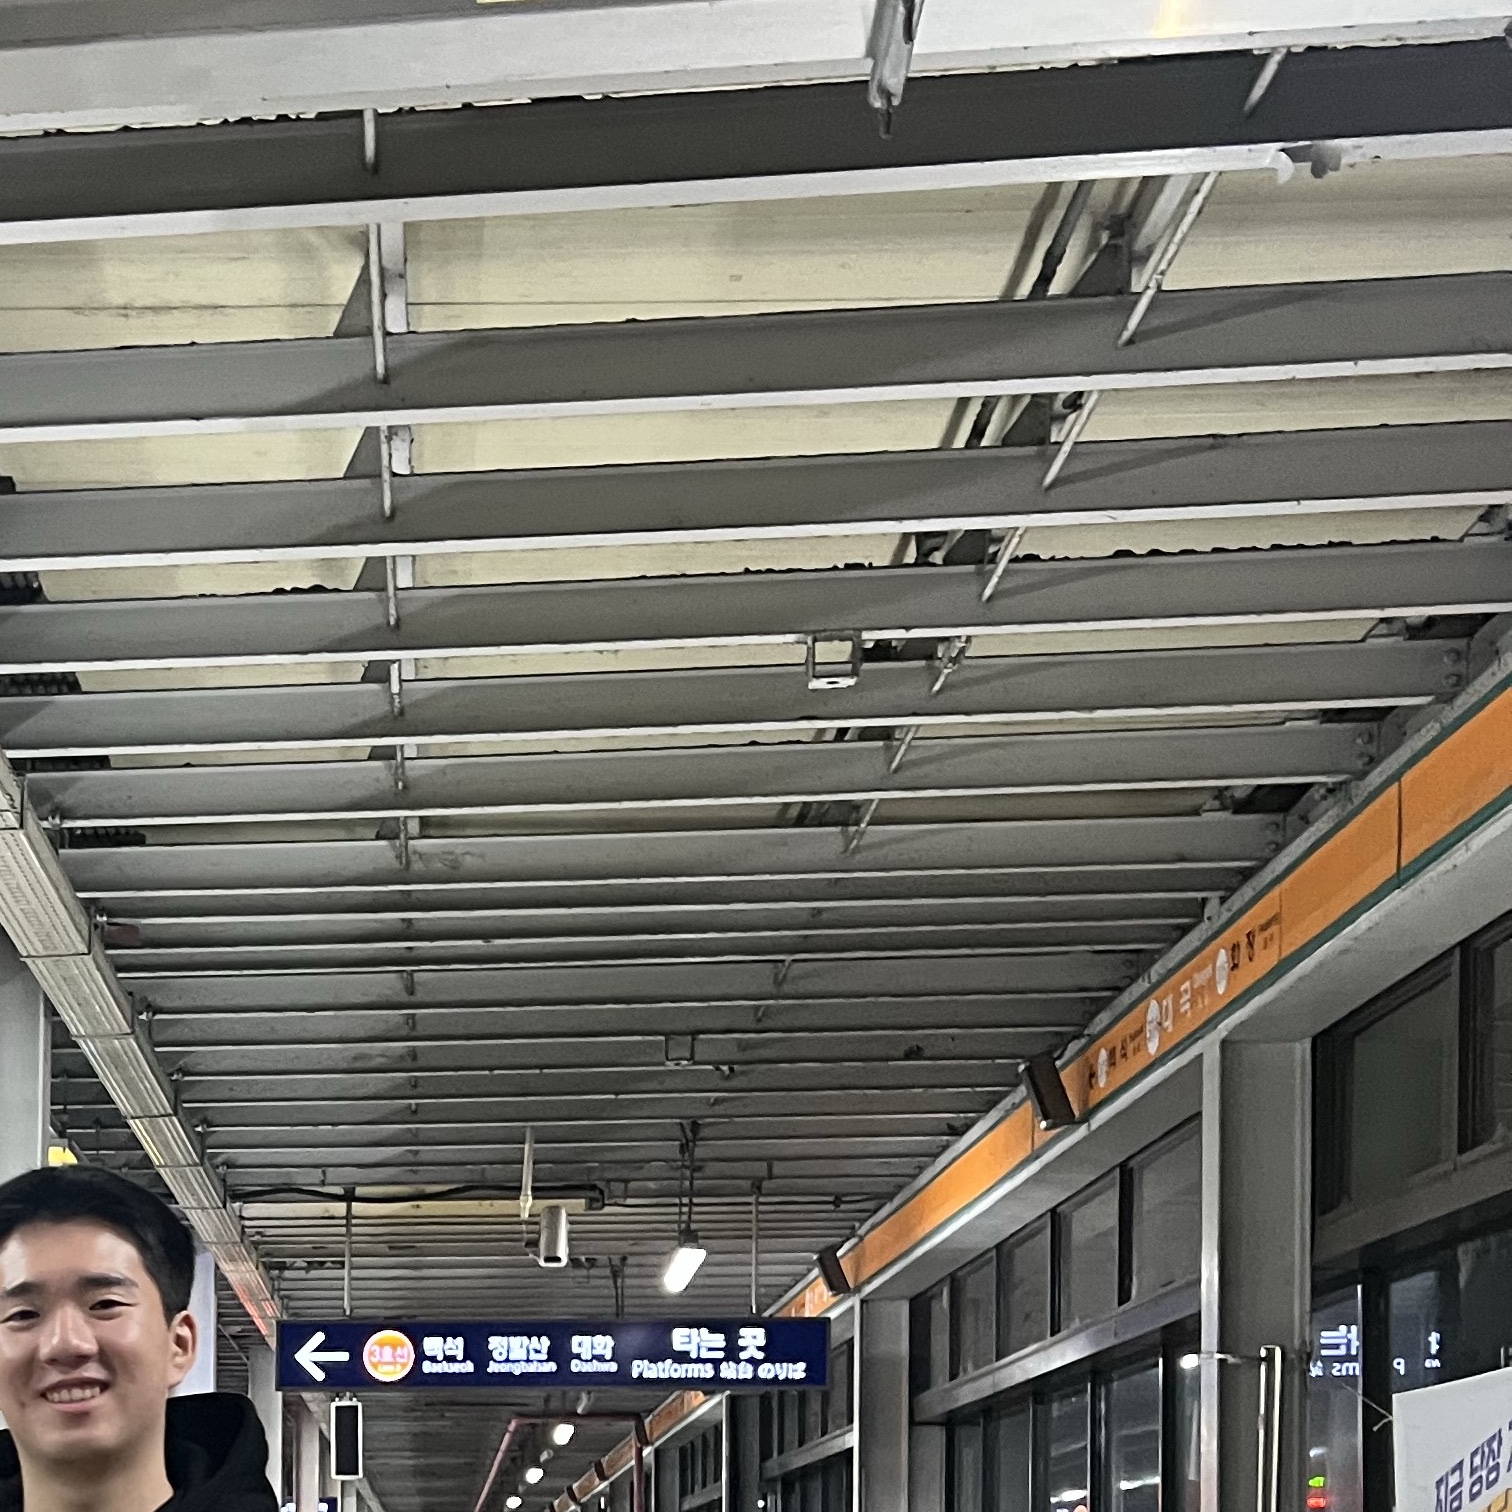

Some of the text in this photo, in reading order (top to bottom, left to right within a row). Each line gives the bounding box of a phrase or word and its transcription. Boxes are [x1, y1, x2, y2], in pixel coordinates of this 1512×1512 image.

[423, 1335, 615, 1361] 백석 정발산 대화
[672, 1327, 766, 1360] 타는 곳
[631, 1359, 715, 1379] Platforms
[1469, 1428, 1502, 1504] 당장
